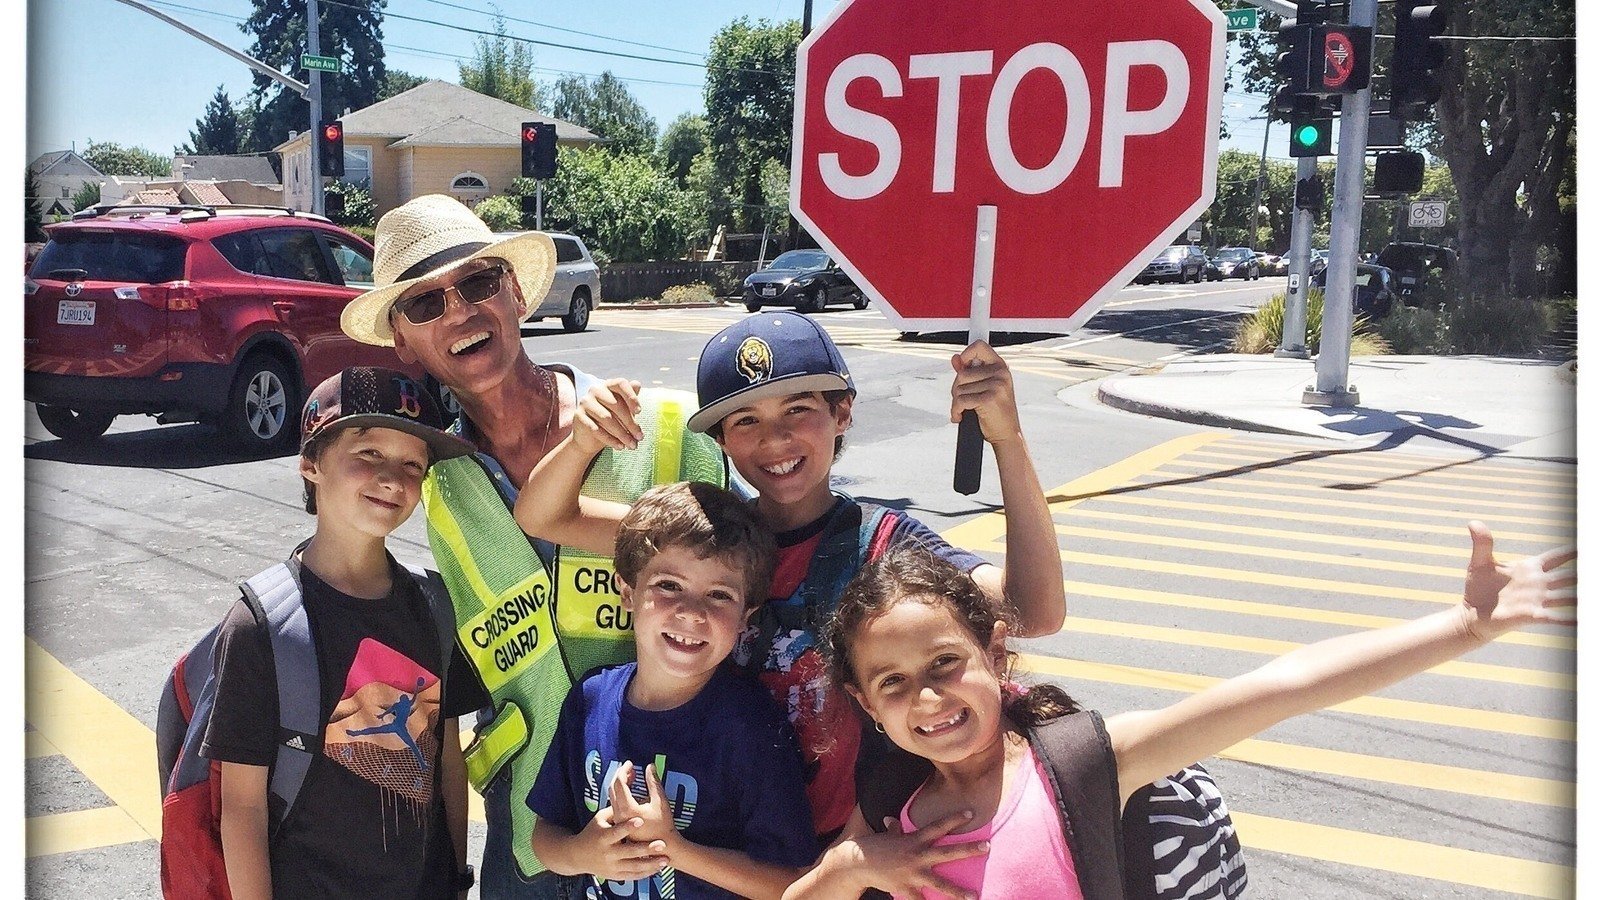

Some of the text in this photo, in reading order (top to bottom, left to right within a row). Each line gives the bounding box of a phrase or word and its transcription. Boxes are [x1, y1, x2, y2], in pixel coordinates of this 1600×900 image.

[304, 58, 335, 69] Marin Ave
[817, 39, 1191, 200] STOP
[392, 377, 420, 417] B
[471, 583, 546, 649] CROSSING
[494, 624, 539, 673] GUARD
